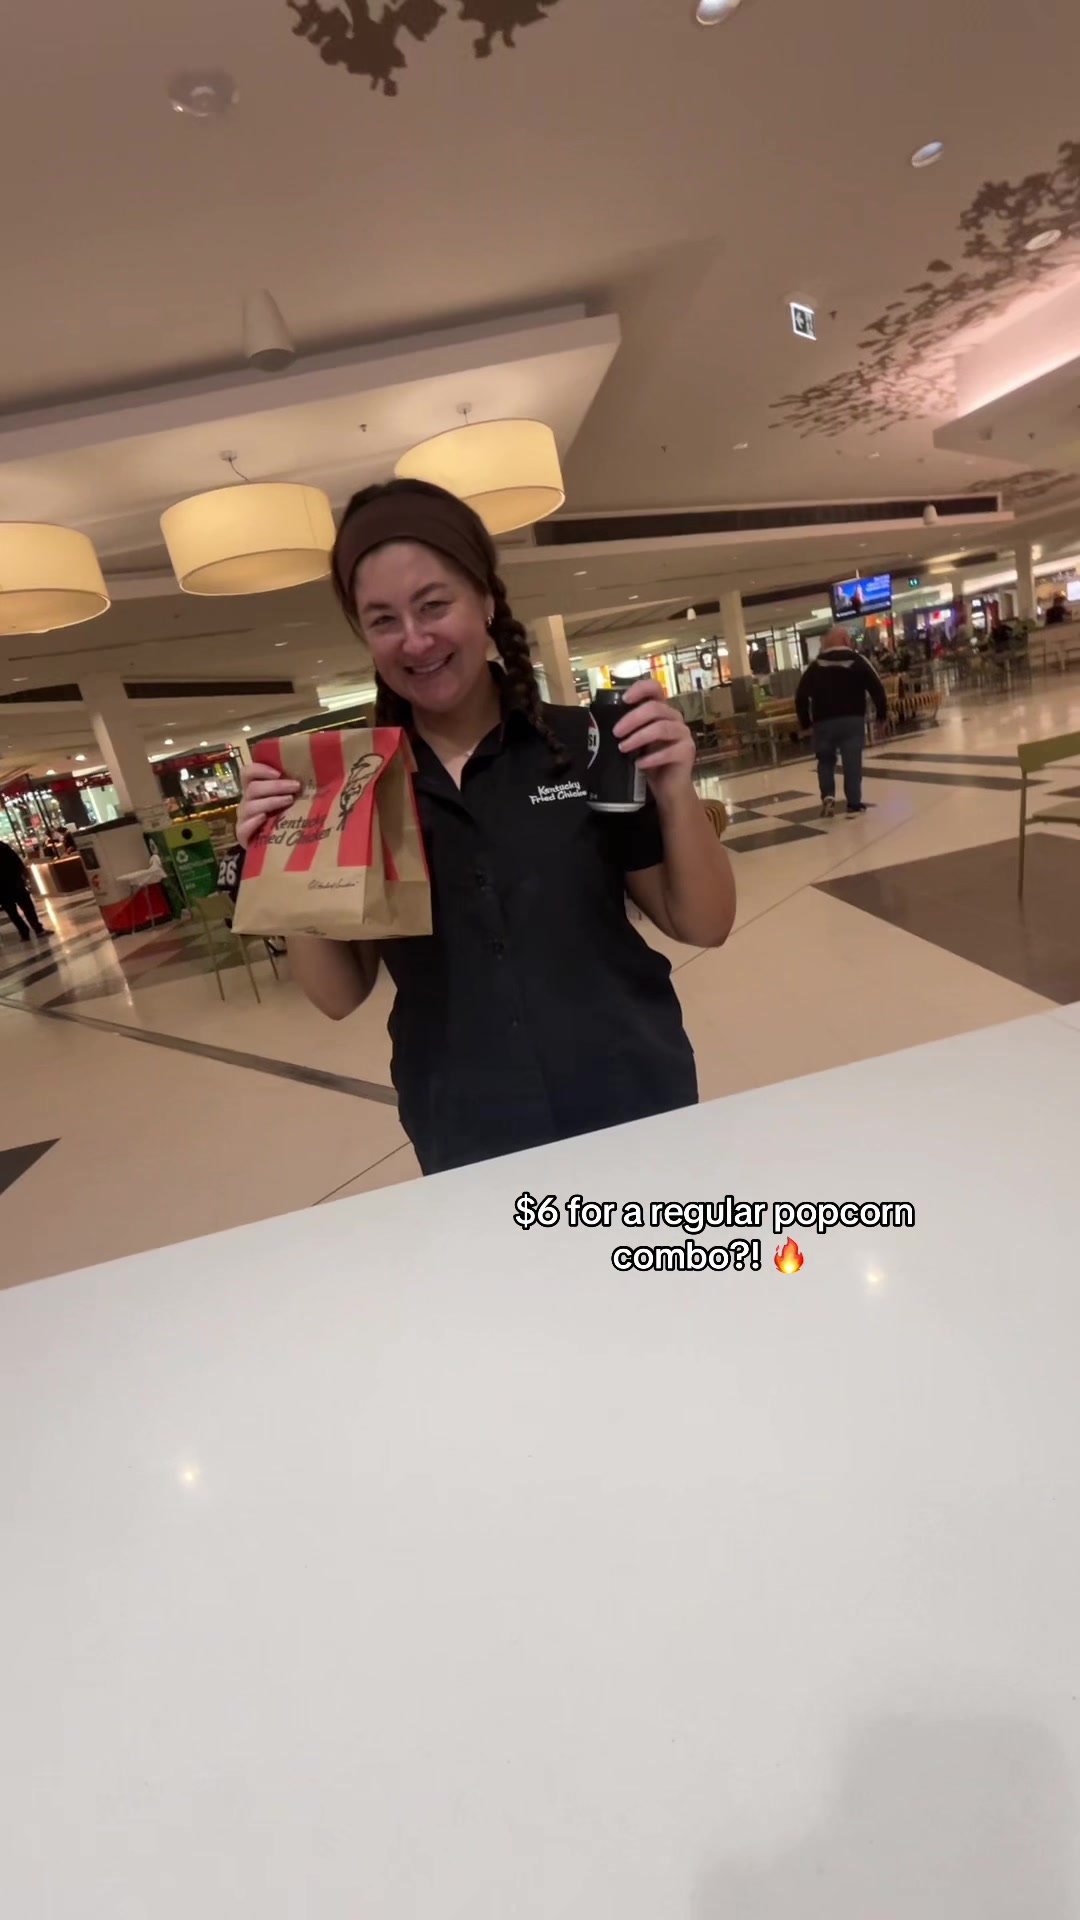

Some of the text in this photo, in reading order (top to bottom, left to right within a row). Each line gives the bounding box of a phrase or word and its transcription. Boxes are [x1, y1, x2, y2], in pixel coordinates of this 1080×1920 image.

[537, 781, 581, 795] Kentucky
[529, 793, 556, 805] Fried
[217, 861, 237, 885] 26
